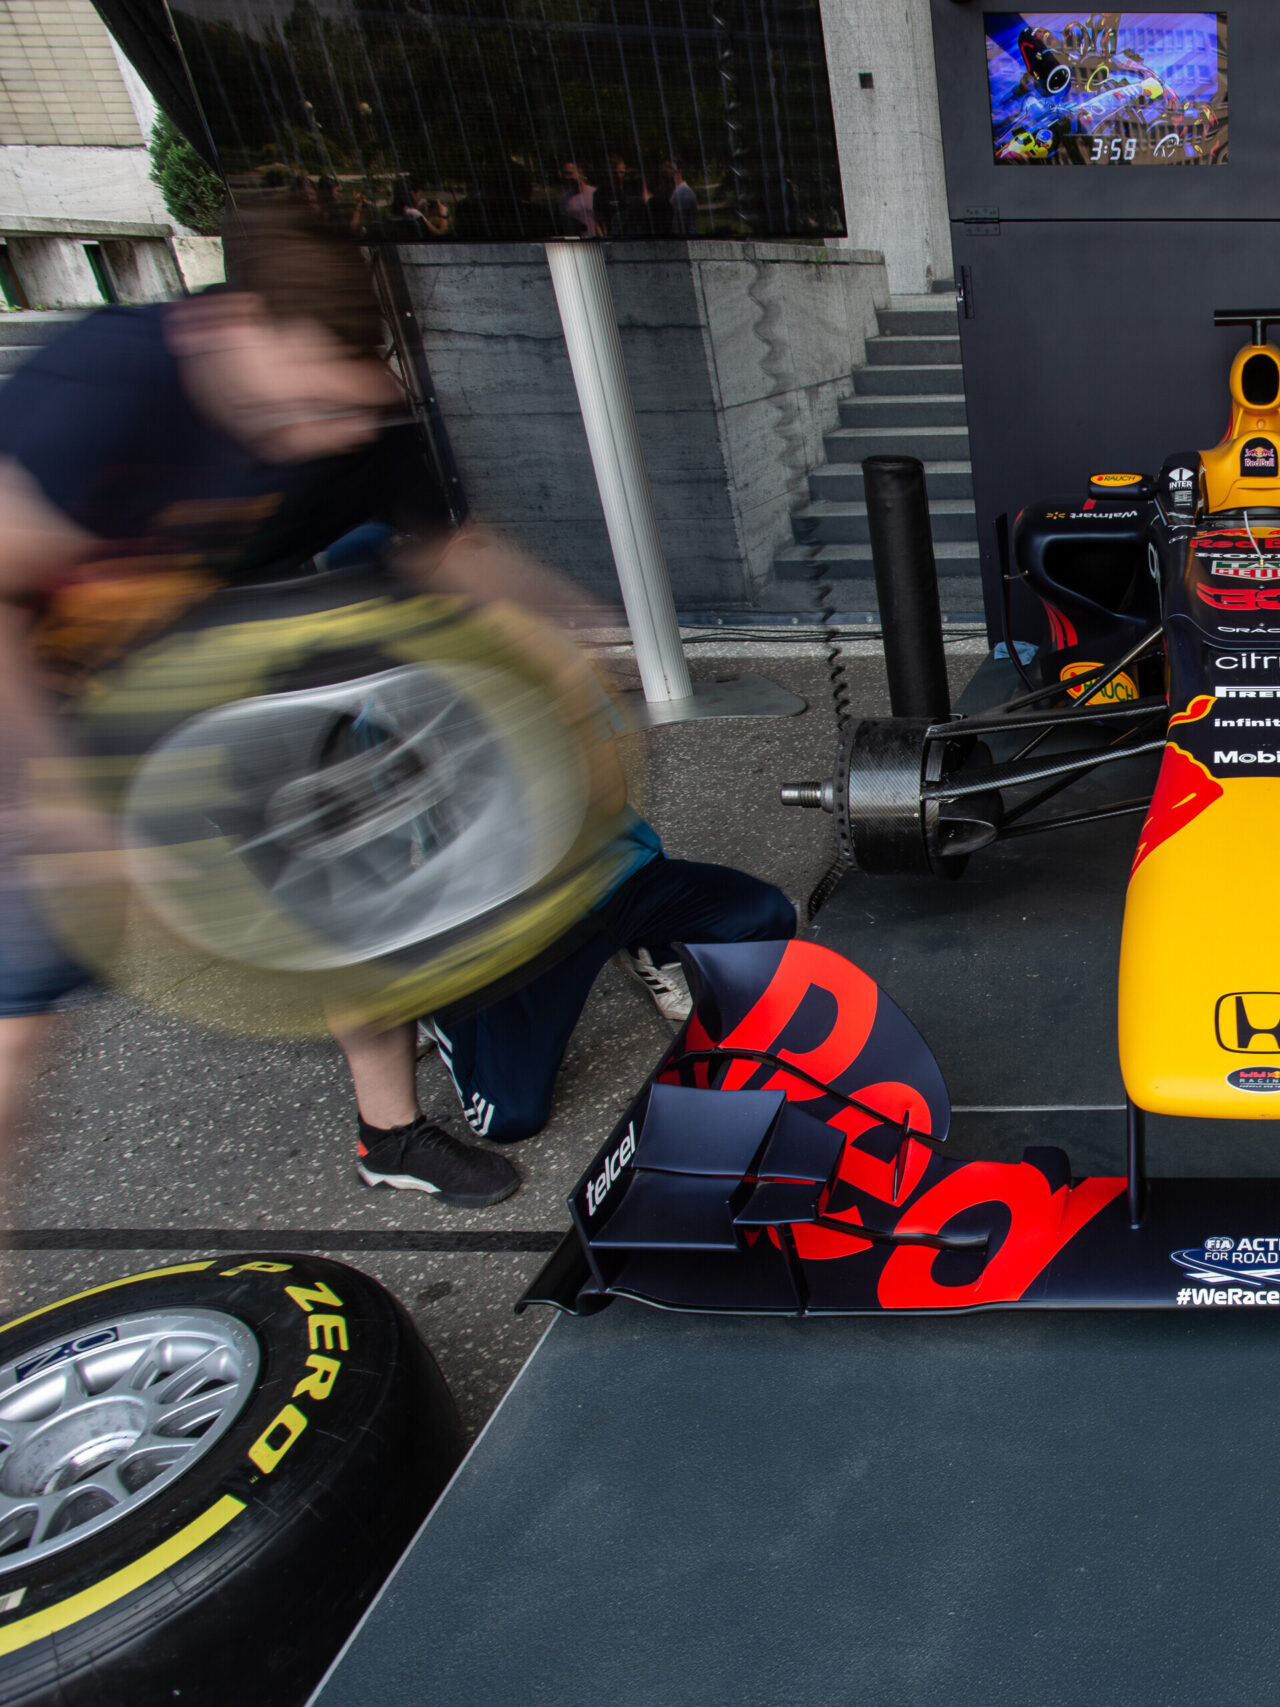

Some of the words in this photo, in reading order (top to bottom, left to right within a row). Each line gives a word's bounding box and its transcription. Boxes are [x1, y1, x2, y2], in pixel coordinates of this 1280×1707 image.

[1090, 138, 1137, 161] 3:58
[1169, 480, 1192, 489] INTER
[1069, 510, 1138, 519] Walmart
[1189, 538, 1258, 549] Red
[586, 1120, 636, 1216] telcel
[1206, 1238, 1234, 1250] FIA
[1204, 1252, 1229, 1261] FOR
[1232, 1252, 1279, 1264] ROAD
[219, 1260, 293, 1277] P
[248, 1281, 349, 1475] ZERO
